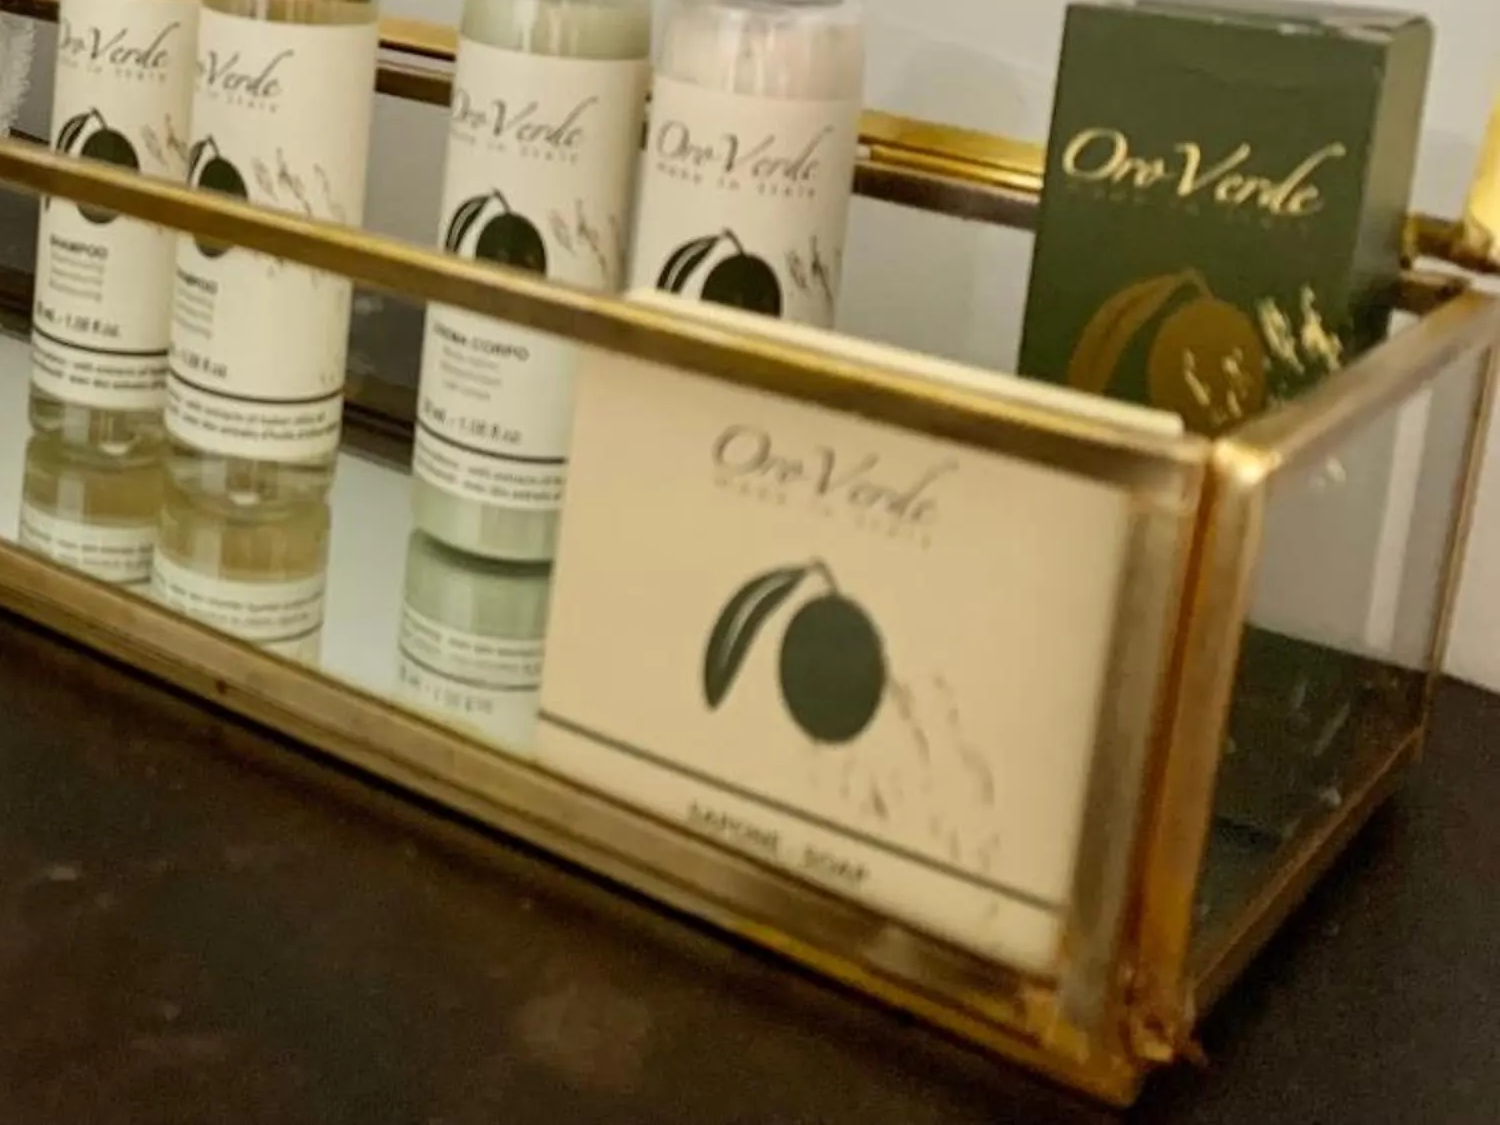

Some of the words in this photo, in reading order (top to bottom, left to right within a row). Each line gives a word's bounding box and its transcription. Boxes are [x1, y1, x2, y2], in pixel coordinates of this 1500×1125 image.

[91, 22, 180, 69] Verde
[208, 48, 294, 98] Verde
[493, 95, 599, 145] Verde
[656, 120, 713, 165] Oro
[722, 124, 834, 181] Verde
[1062, 128, 1167, 184] Oro
[1176, 142, 1346, 217] Verde
[711, 424, 803, 478] Oro
[817, 445, 960, 523] Verde
